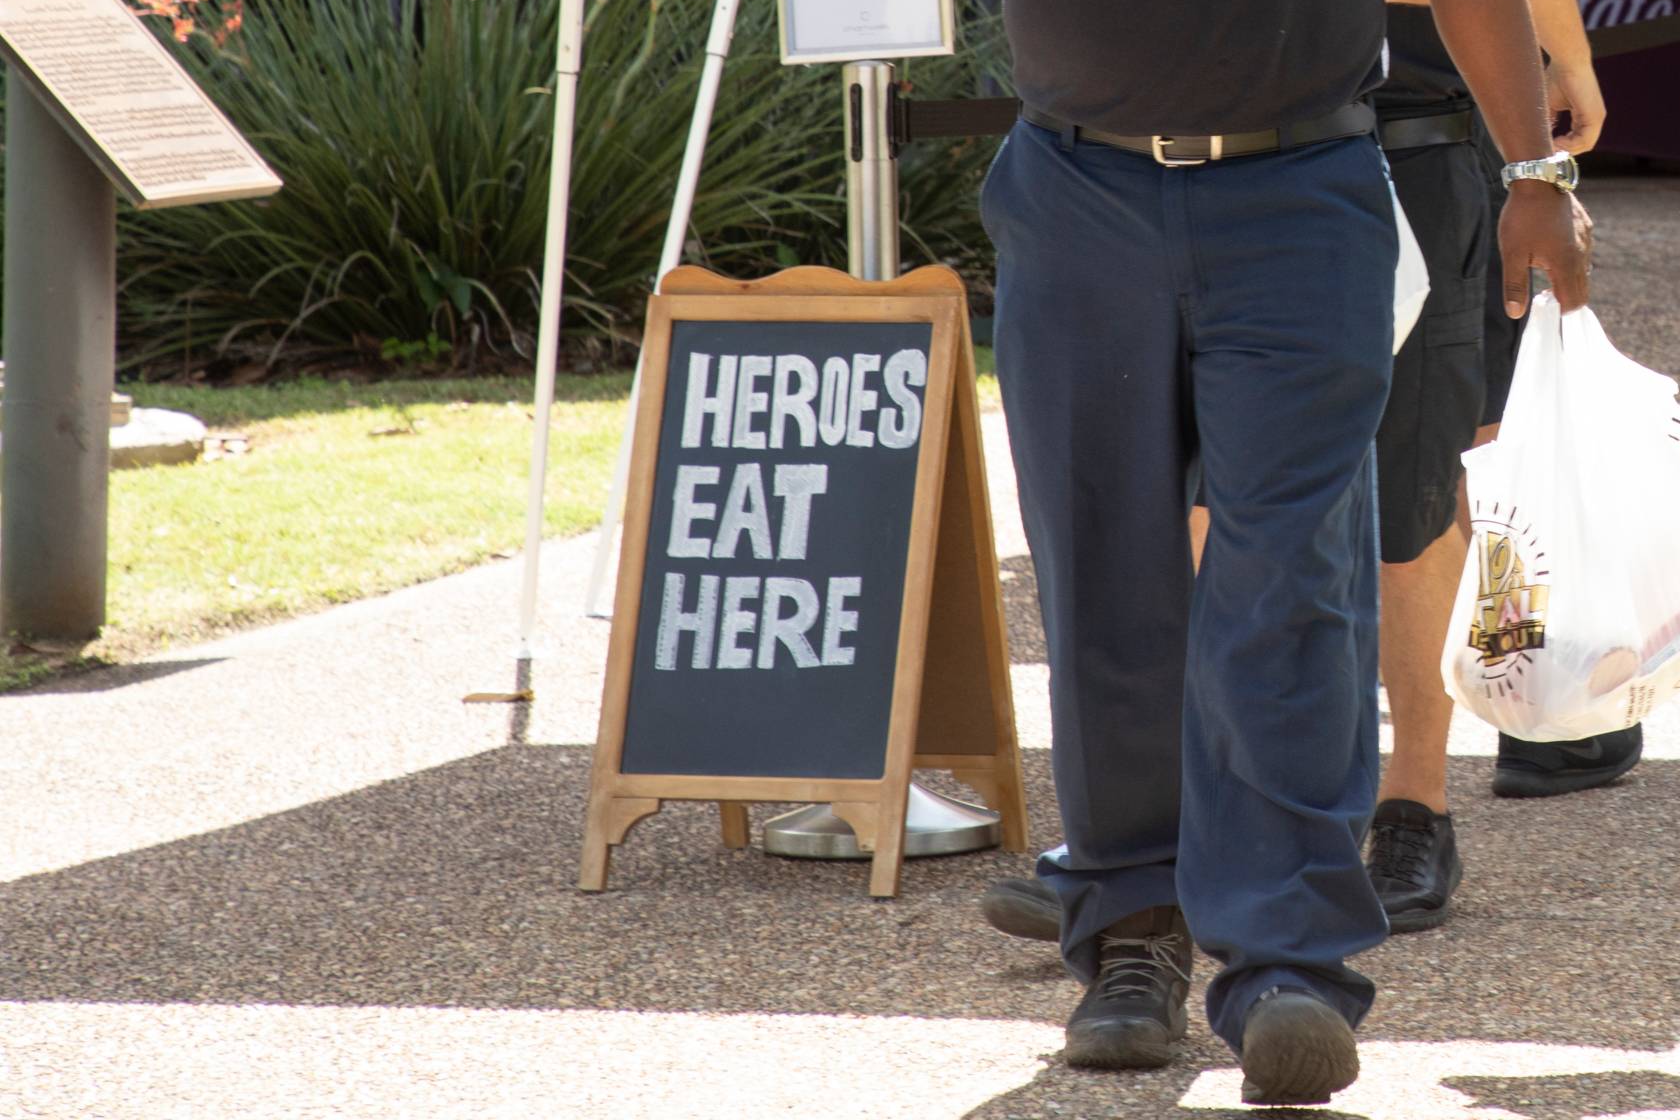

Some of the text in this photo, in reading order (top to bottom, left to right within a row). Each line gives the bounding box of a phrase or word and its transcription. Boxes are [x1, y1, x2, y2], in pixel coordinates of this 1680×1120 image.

[681, 348, 928, 450] HEROES
[666, 462, 829, 561] EAT
[655, 572, 863, 671] HERE
